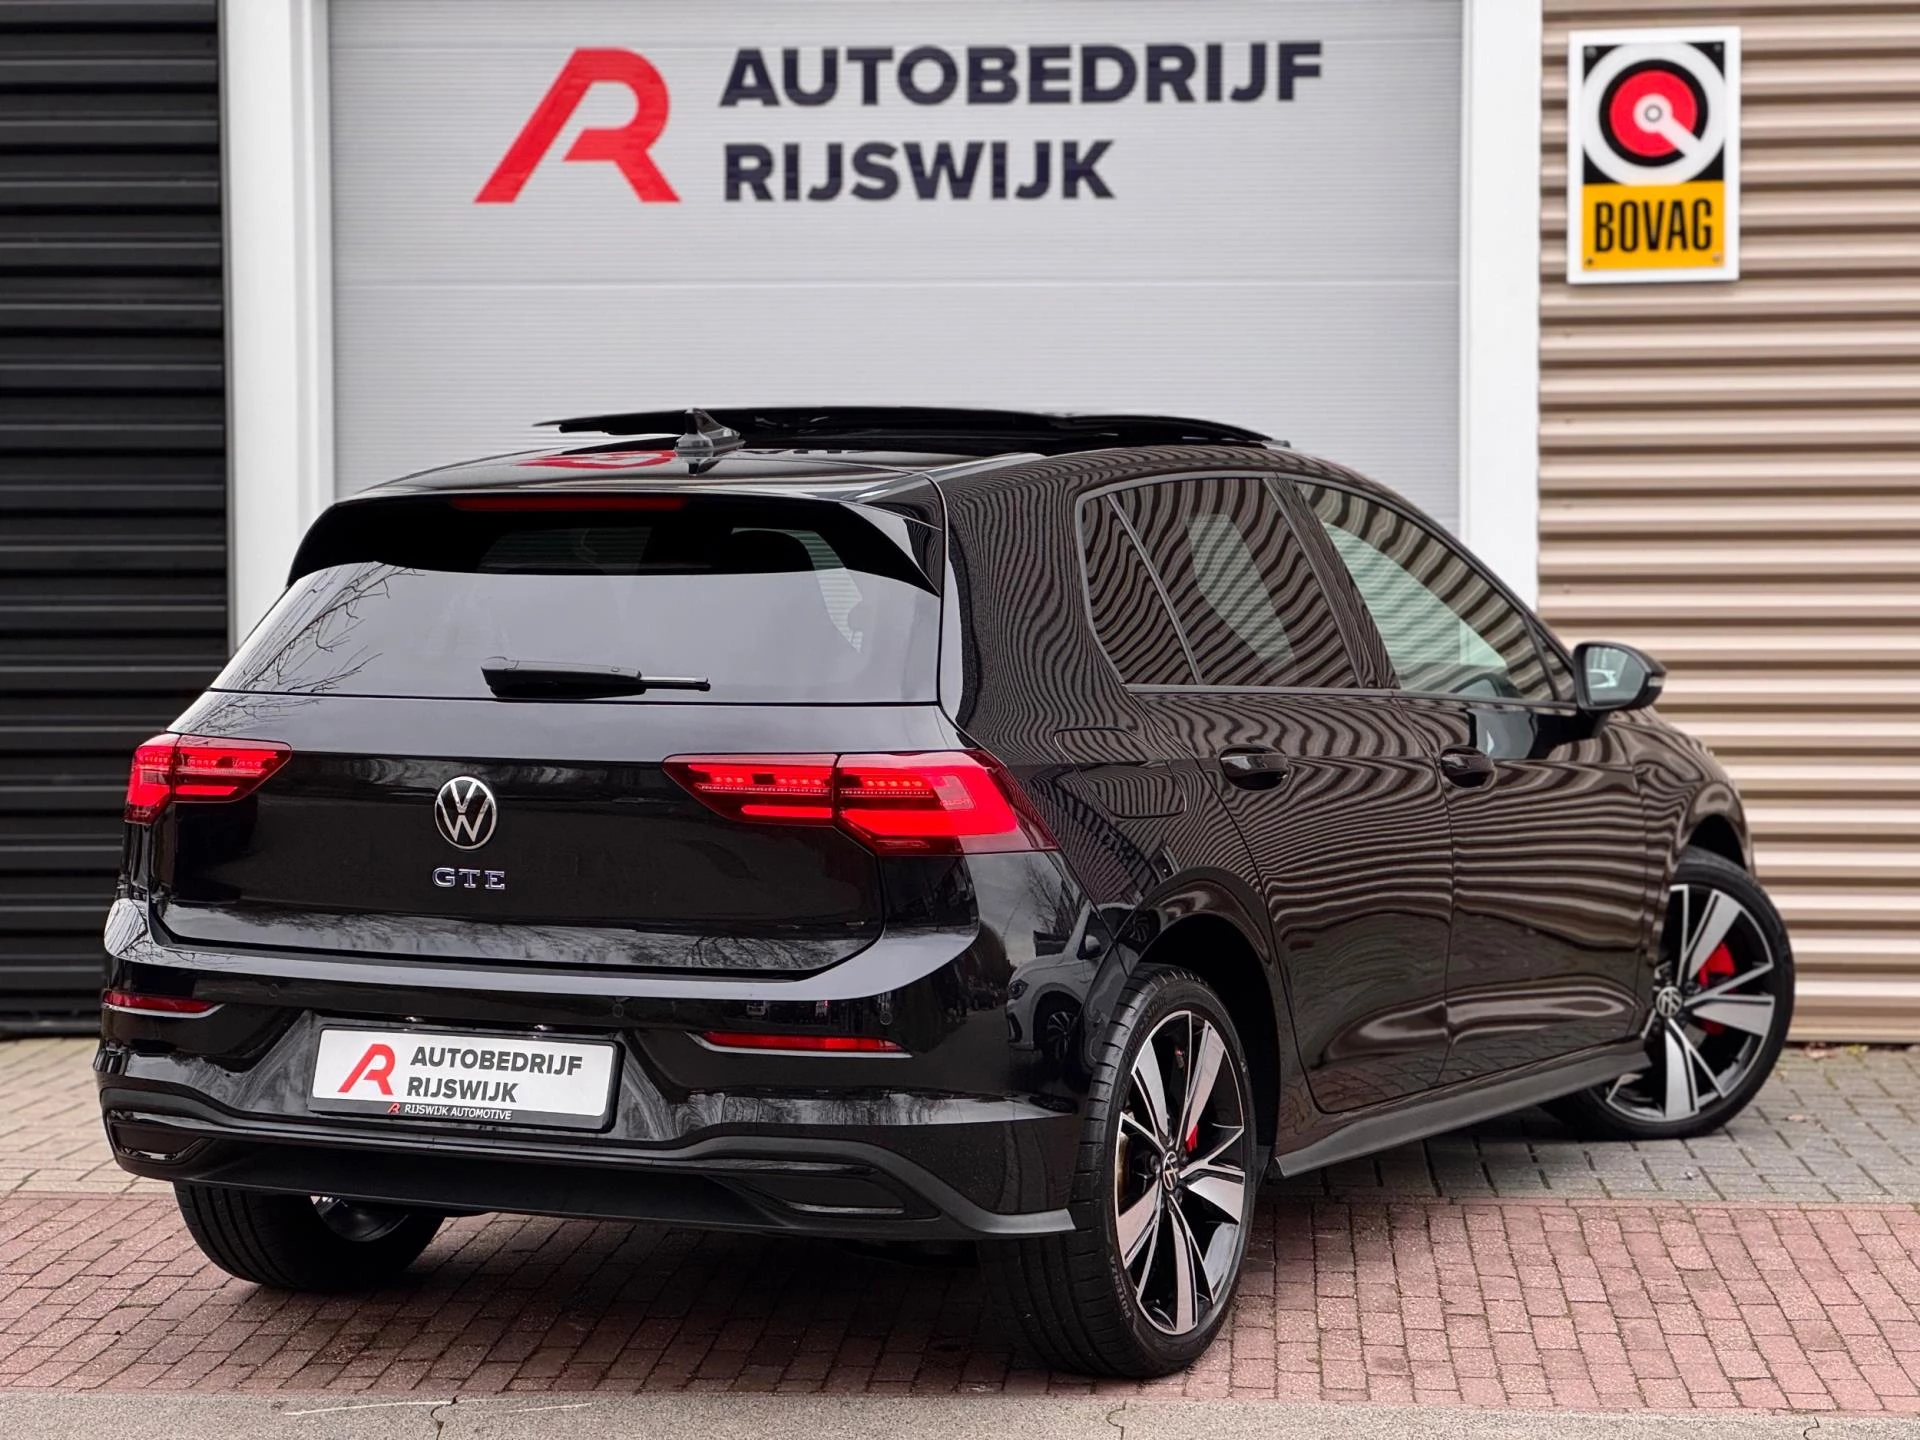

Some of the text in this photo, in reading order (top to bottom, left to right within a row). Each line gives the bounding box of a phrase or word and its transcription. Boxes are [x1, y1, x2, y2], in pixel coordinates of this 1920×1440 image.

[719, 42, 1322, 107] AUTOBEDRIJF
[723, 140, 1115, 202] RIJSWIJK
[1595, 198, 1712, 253] BOVAG
[432, 867, 505, 890] GTE
[410, 1046, 582, 1076] AUTOBEDRIJF
[406, 1077, 518, 1103] RIJSWIJK
[404, 1103, 449, 1116] RIJSWIJK
[450, 1107, 513, 1120] AUTOMOTIVE
